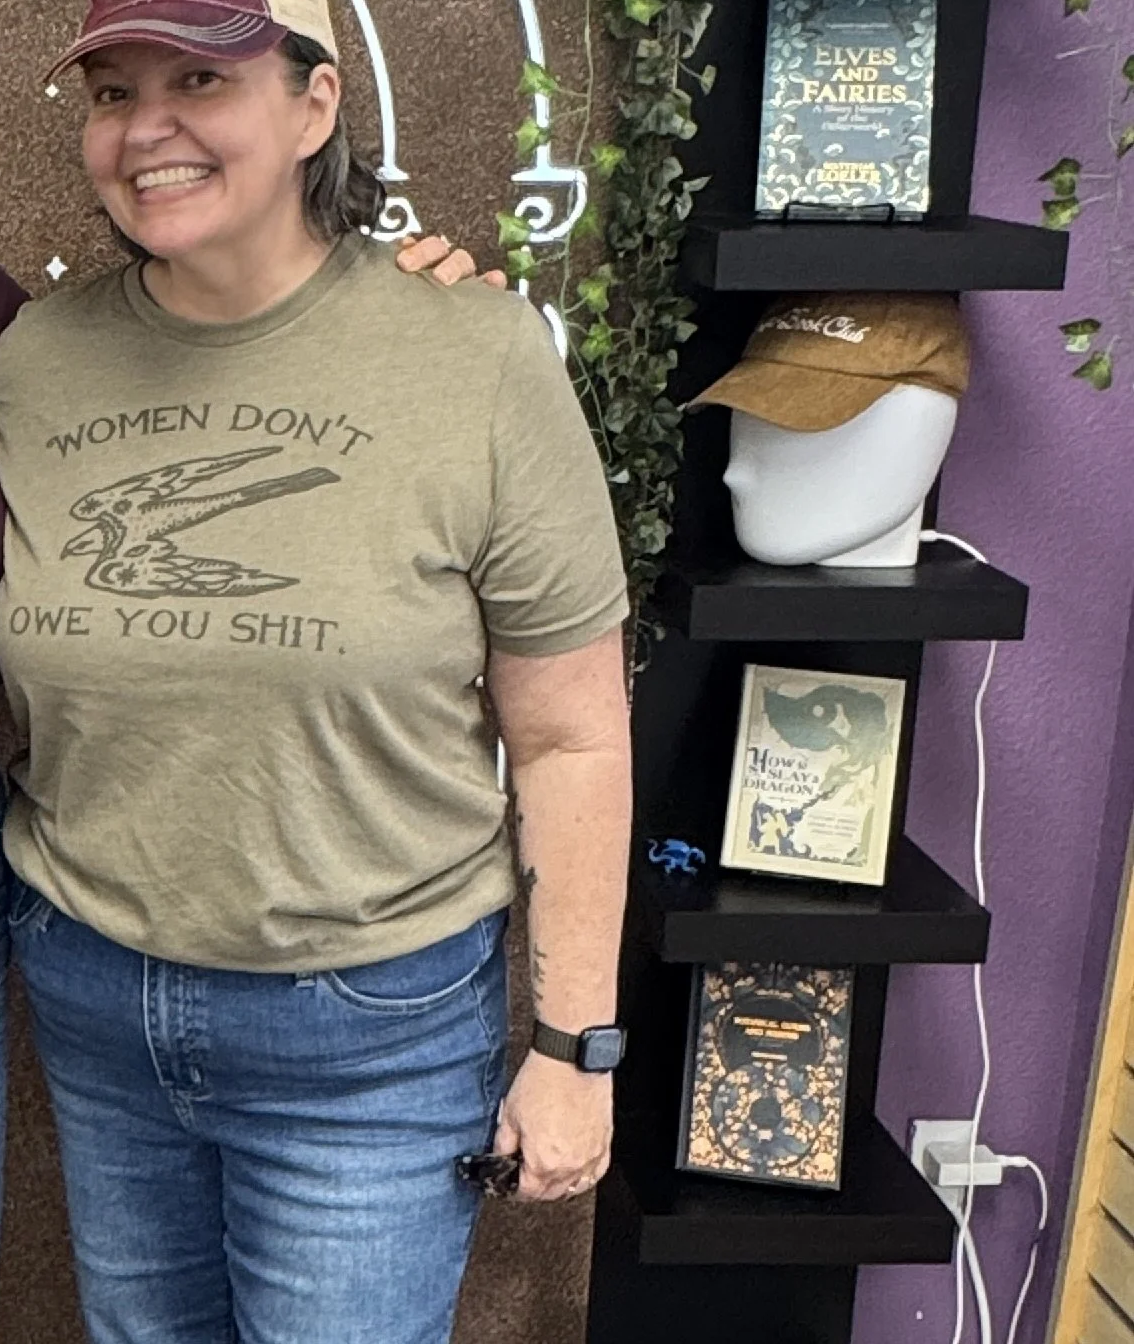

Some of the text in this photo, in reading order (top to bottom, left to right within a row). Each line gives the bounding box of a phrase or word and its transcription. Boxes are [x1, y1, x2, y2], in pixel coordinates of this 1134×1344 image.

[814, 43, 898, 66] ELVES
[829, 66, 879, 83] AND
[801, 80, 908, 104] FAIRIES
[45, 402, 375, 458] WOMEN DON'T
[8, 605, 347, 656] OWE YOU SHIT.
[744, 778, 814, 796] DRAGON
